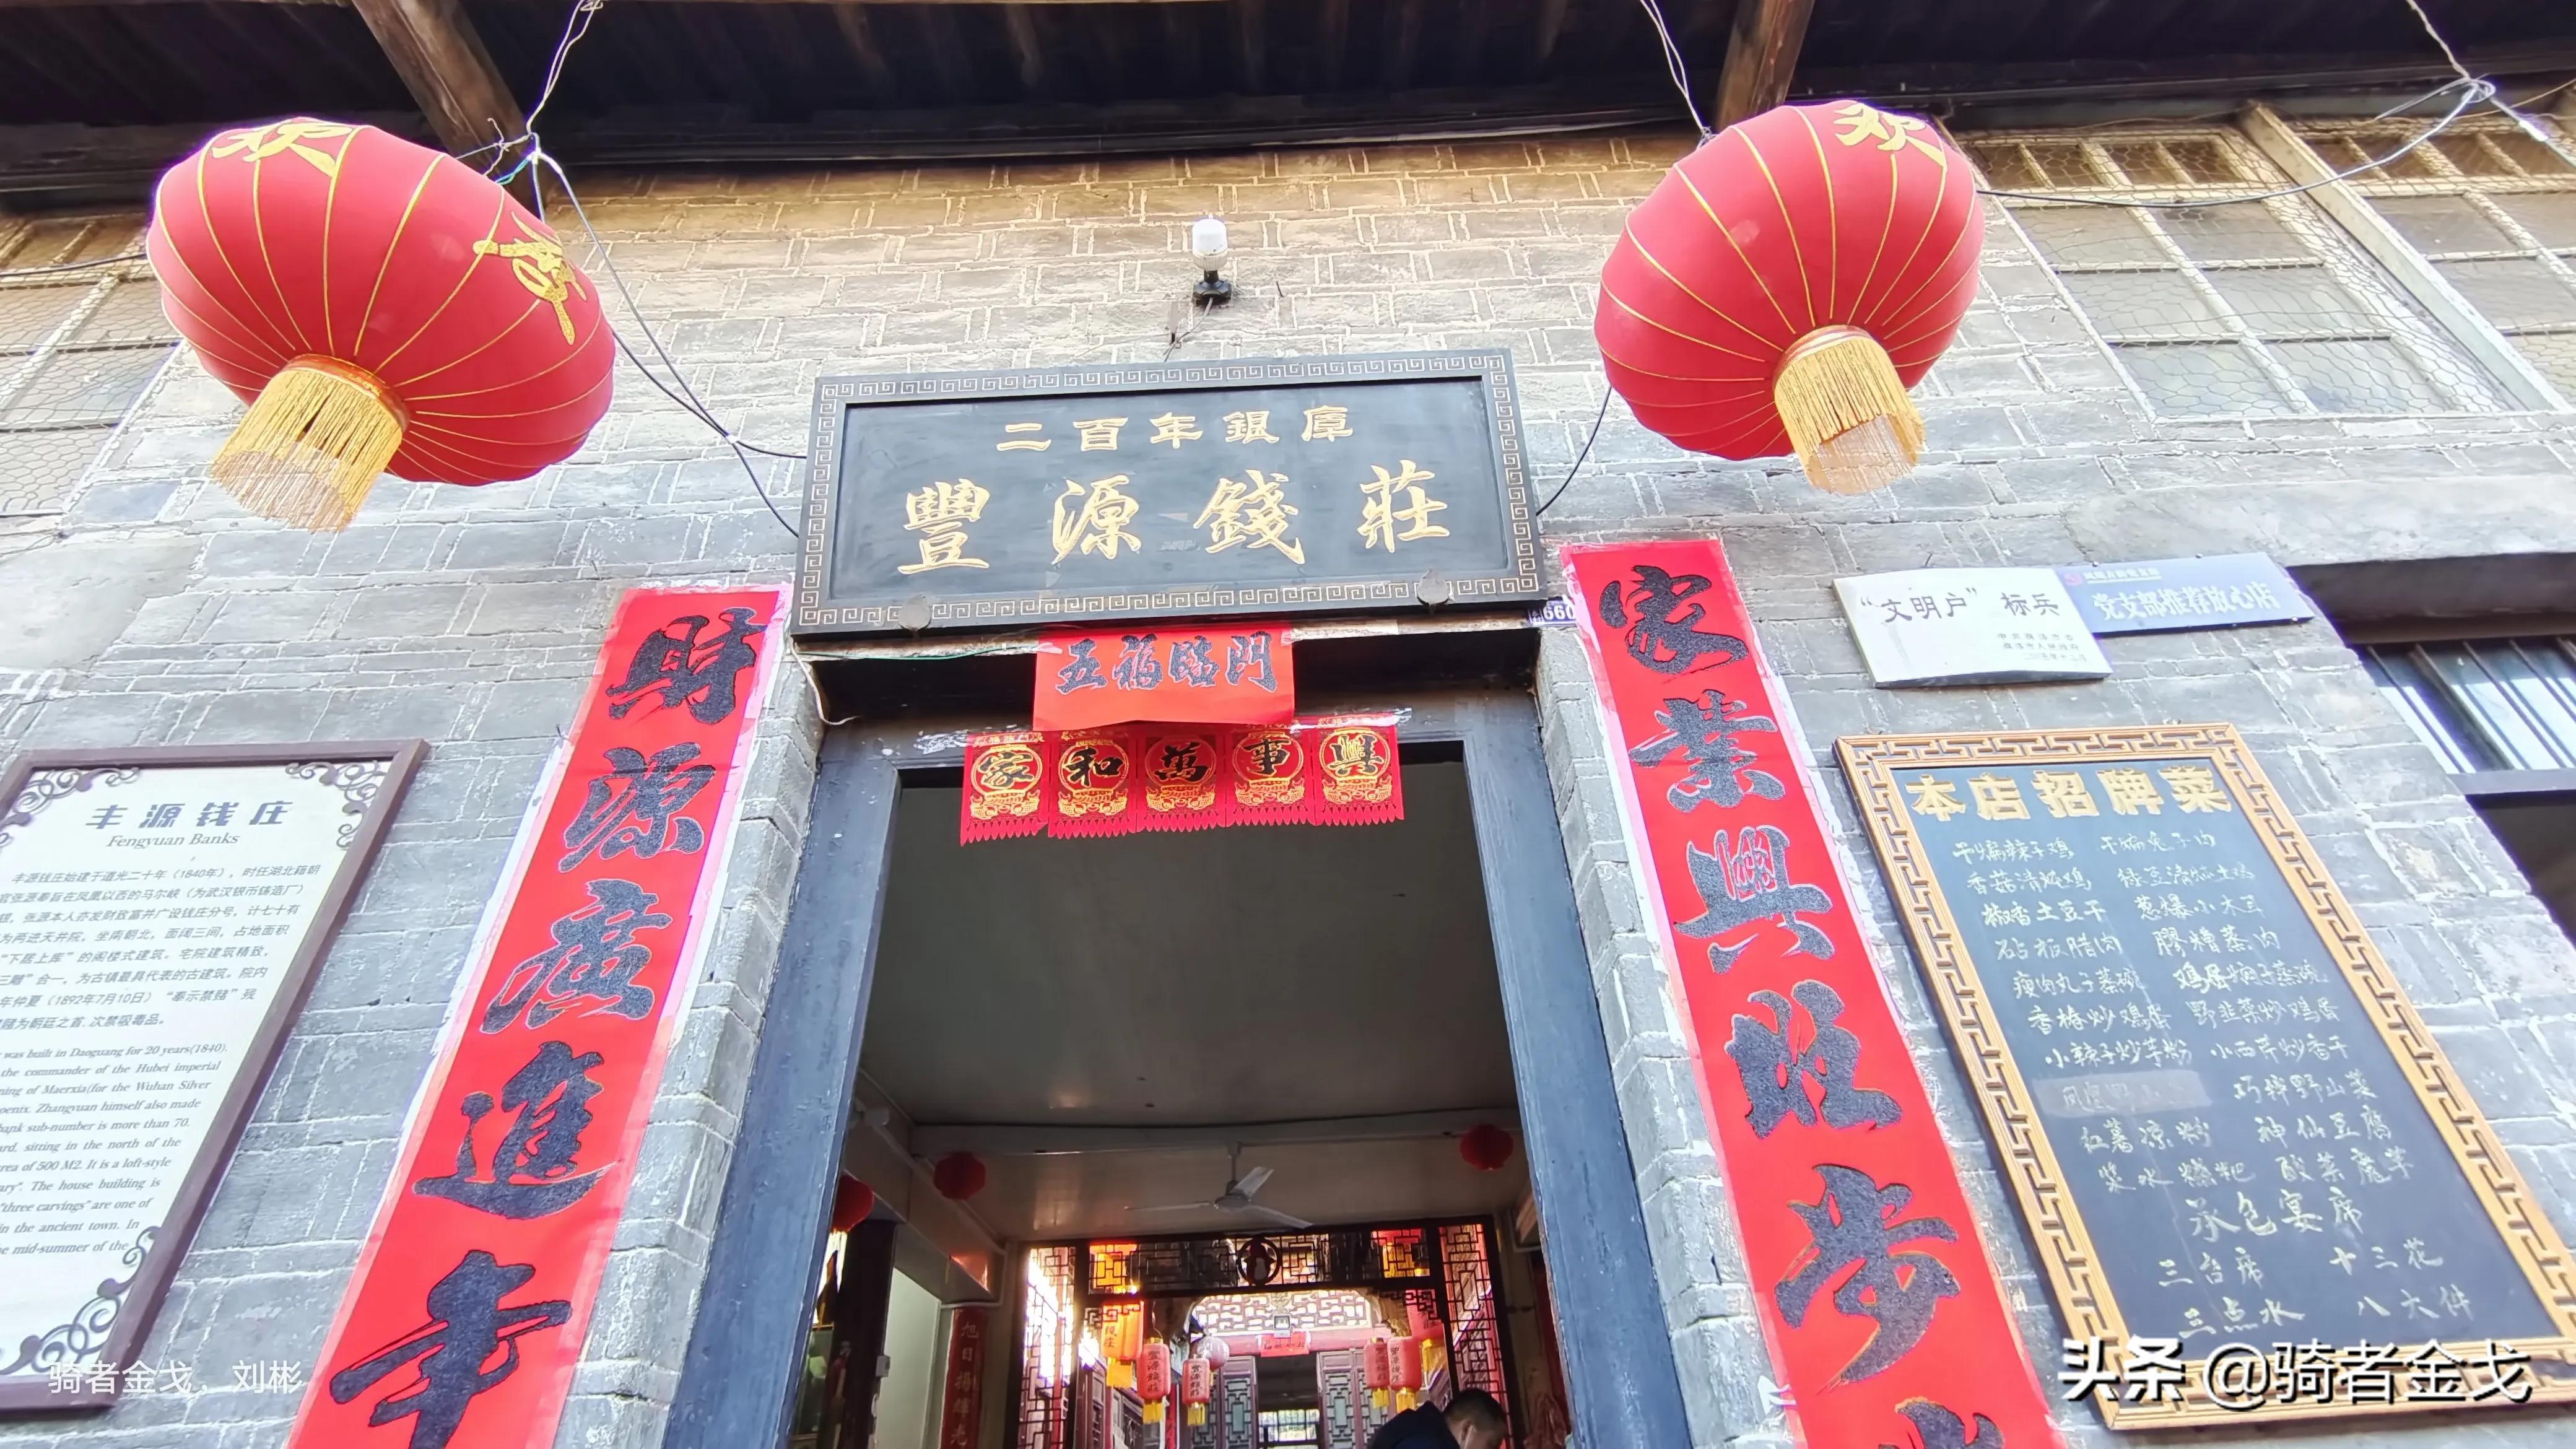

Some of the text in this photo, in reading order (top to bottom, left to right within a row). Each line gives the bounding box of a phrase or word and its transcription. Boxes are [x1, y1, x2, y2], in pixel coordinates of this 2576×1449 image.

[996, 404, 1354, 452] 二百年銀庫
[897, 459, 1451, 575] 豐源錢莊
[2001, 593, 2060, 616] 标兵
[2091, 581, 2281, 620] 党支部推荐放心店
[1055, 630, 1279, 696] 五福臨門
[1905, 765, 2232, 822] 本店招牌菜
[85, 801, 294, 830] 丰源钱庄
[106, 832, 241, 850] Fengyuan Banks
[26, 1049, 53, 1058] built
[54, 1050, 67, 1058] in
[69, 1048, 124, 1058] Daoguang
[125, 1046, 144, 1056] for
[144, 1045, 160, 1055] 20
[1, 1060, 222, 1077] the commander of the Hubei imperial
[26, 1085, 41, 1095] of
[111, 1082, 131, 1092] the
[136, 1081, 175, 1090] Wuhan
[178, 1079, 212, 1090] Silver
[35, 1103, 98, 1115] Zhangyuan
[100, 1100, 146, 1112] himself
[144, 1100, 167, 1110] also
[169, 1099, 202, 1109] made
[26, 1121, 95, 1132] sub-number
[97, 1121, 108, 1130] is
[110, 1121, 141, 1130] more
[143, 1119, 170, 1129] than
[173, 1118, 190, 1128] 70.
[24, 1142, 61, 1154] sitting
[64, 1141, 78, 1150] in
[83, 1140, 103, 1150] the
[107, 1138, 140, 1149] north
[144, 1138, 161, 1147] of
[162, 1137, 181, 1147] the
[21, 1161, 38, 1172] of
[35, 1160, 61, 1171] 500
[85, 1159, 98, 1170] It
[98, 1159, 110, 1169] is
[121, 1157, 172, 1170] loft-style
[31, 1181, 54, 1191] The
[58, 1180, 94, 1190] house
[98, 1178, 147, 1190] building
[150, 1177, 162, 1188] is
[90, 1201, 113, 1210] are
[114, 1201, 136, 1209] one
[137, 1198, 155, 1208] of
[14, 1222, 35, 1233] the
[38, 1221, 84, 1232] ancient
[88, 1222, 120, 1231] town.
[126, 1219, 140, 1230] In
[12, 1242, 91, 1255] mid-summer
[93, 1240, 110, 1252] of
[109, 1240, 129, 1251] the
[2330, 1237, 2444, 1276] 十三花
